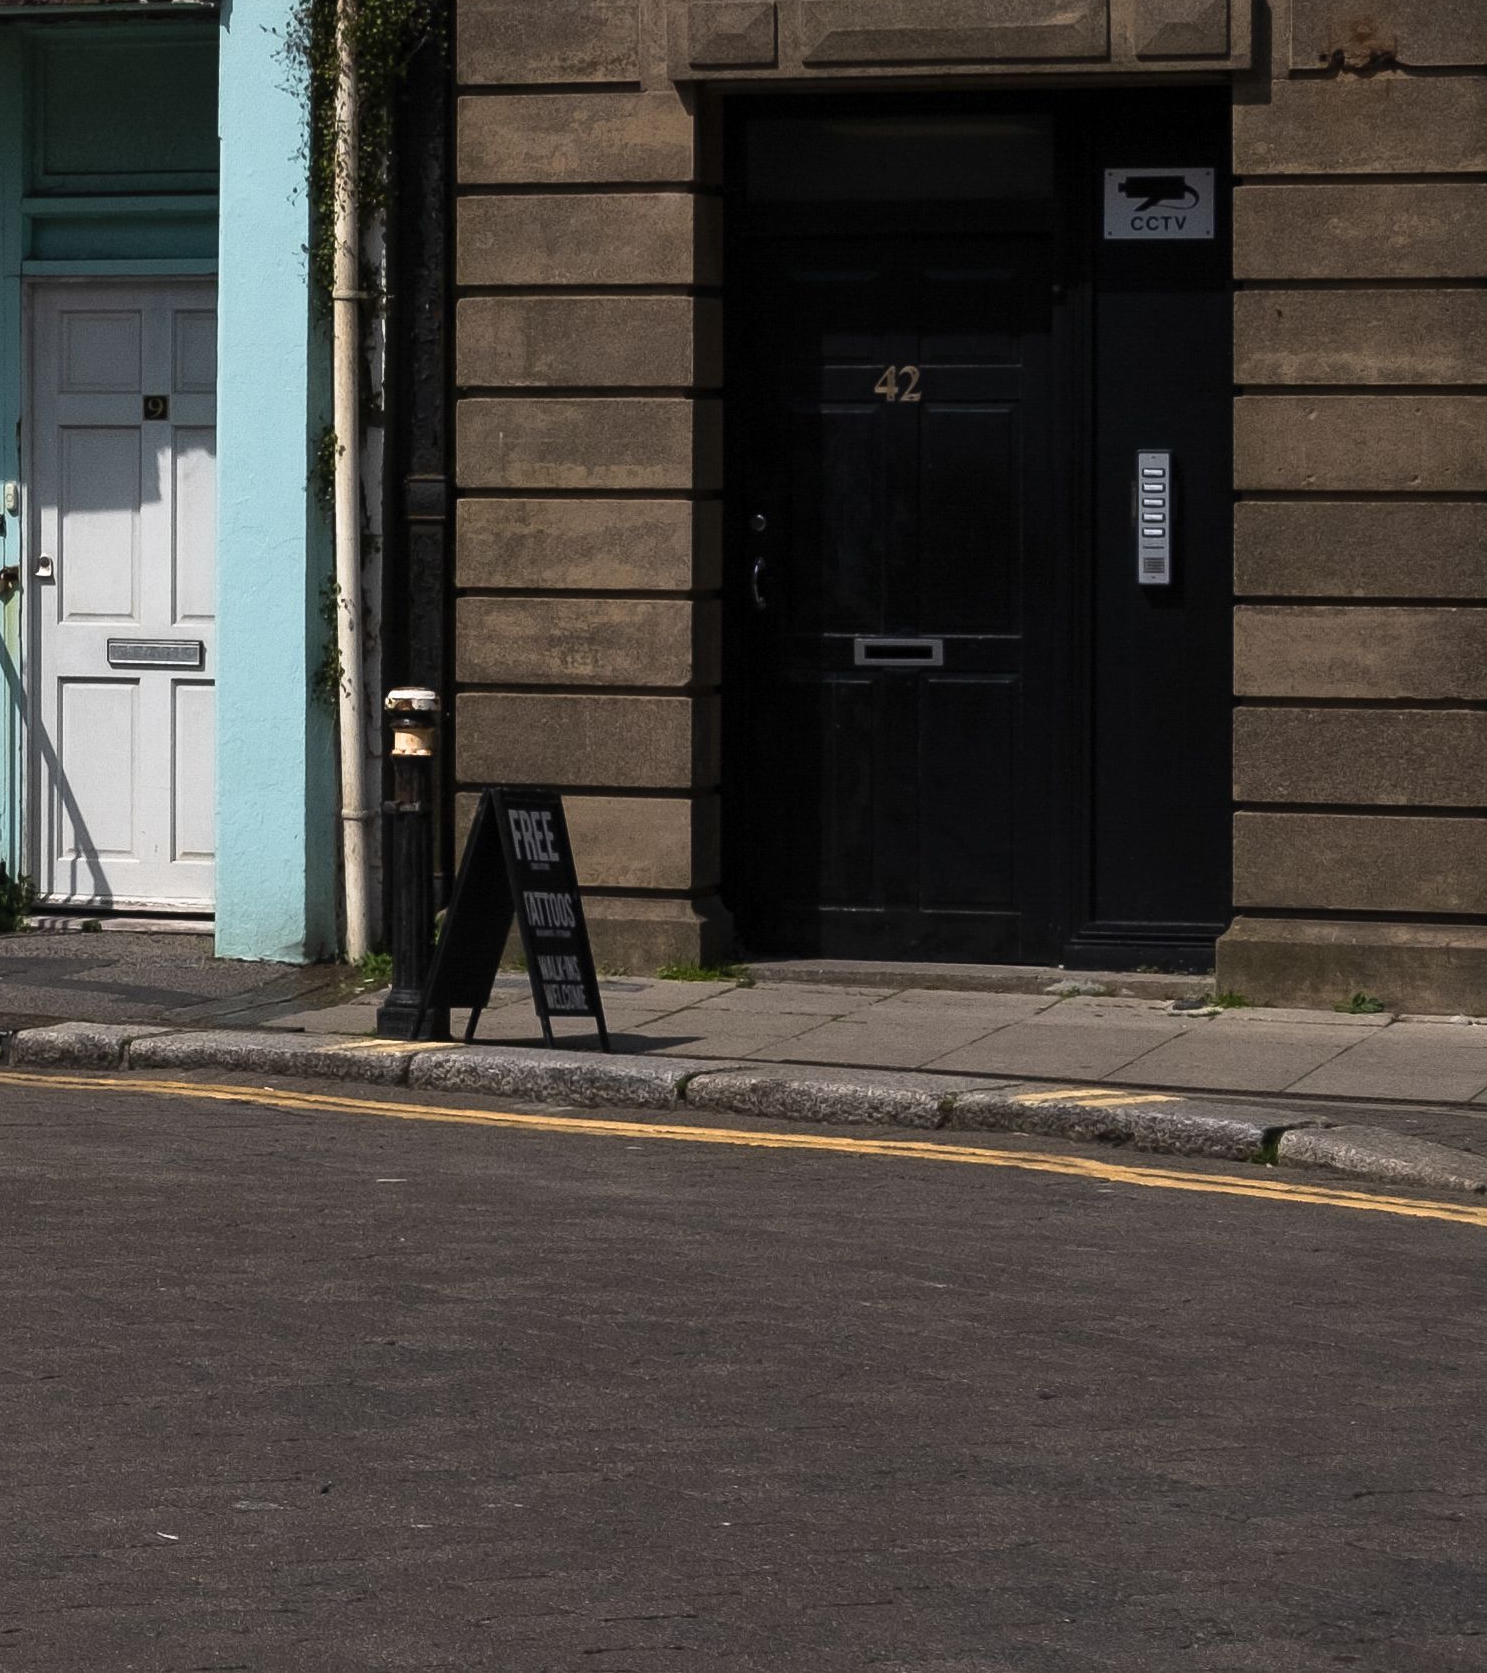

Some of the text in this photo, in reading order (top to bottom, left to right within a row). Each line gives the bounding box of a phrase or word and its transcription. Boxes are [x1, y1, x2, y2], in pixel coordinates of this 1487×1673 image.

[1129, 215, 1187, 232] CCTV
[873, 365, 923, 403] 42
[147, 398, 164, 419] 9
[507, 808, 560, 862] FREE
[522, 890, 577, 928] TATTOOS
[537, 954, 582, 981] WALK-INS
[542, 983, 589, 1011] WELCOME
